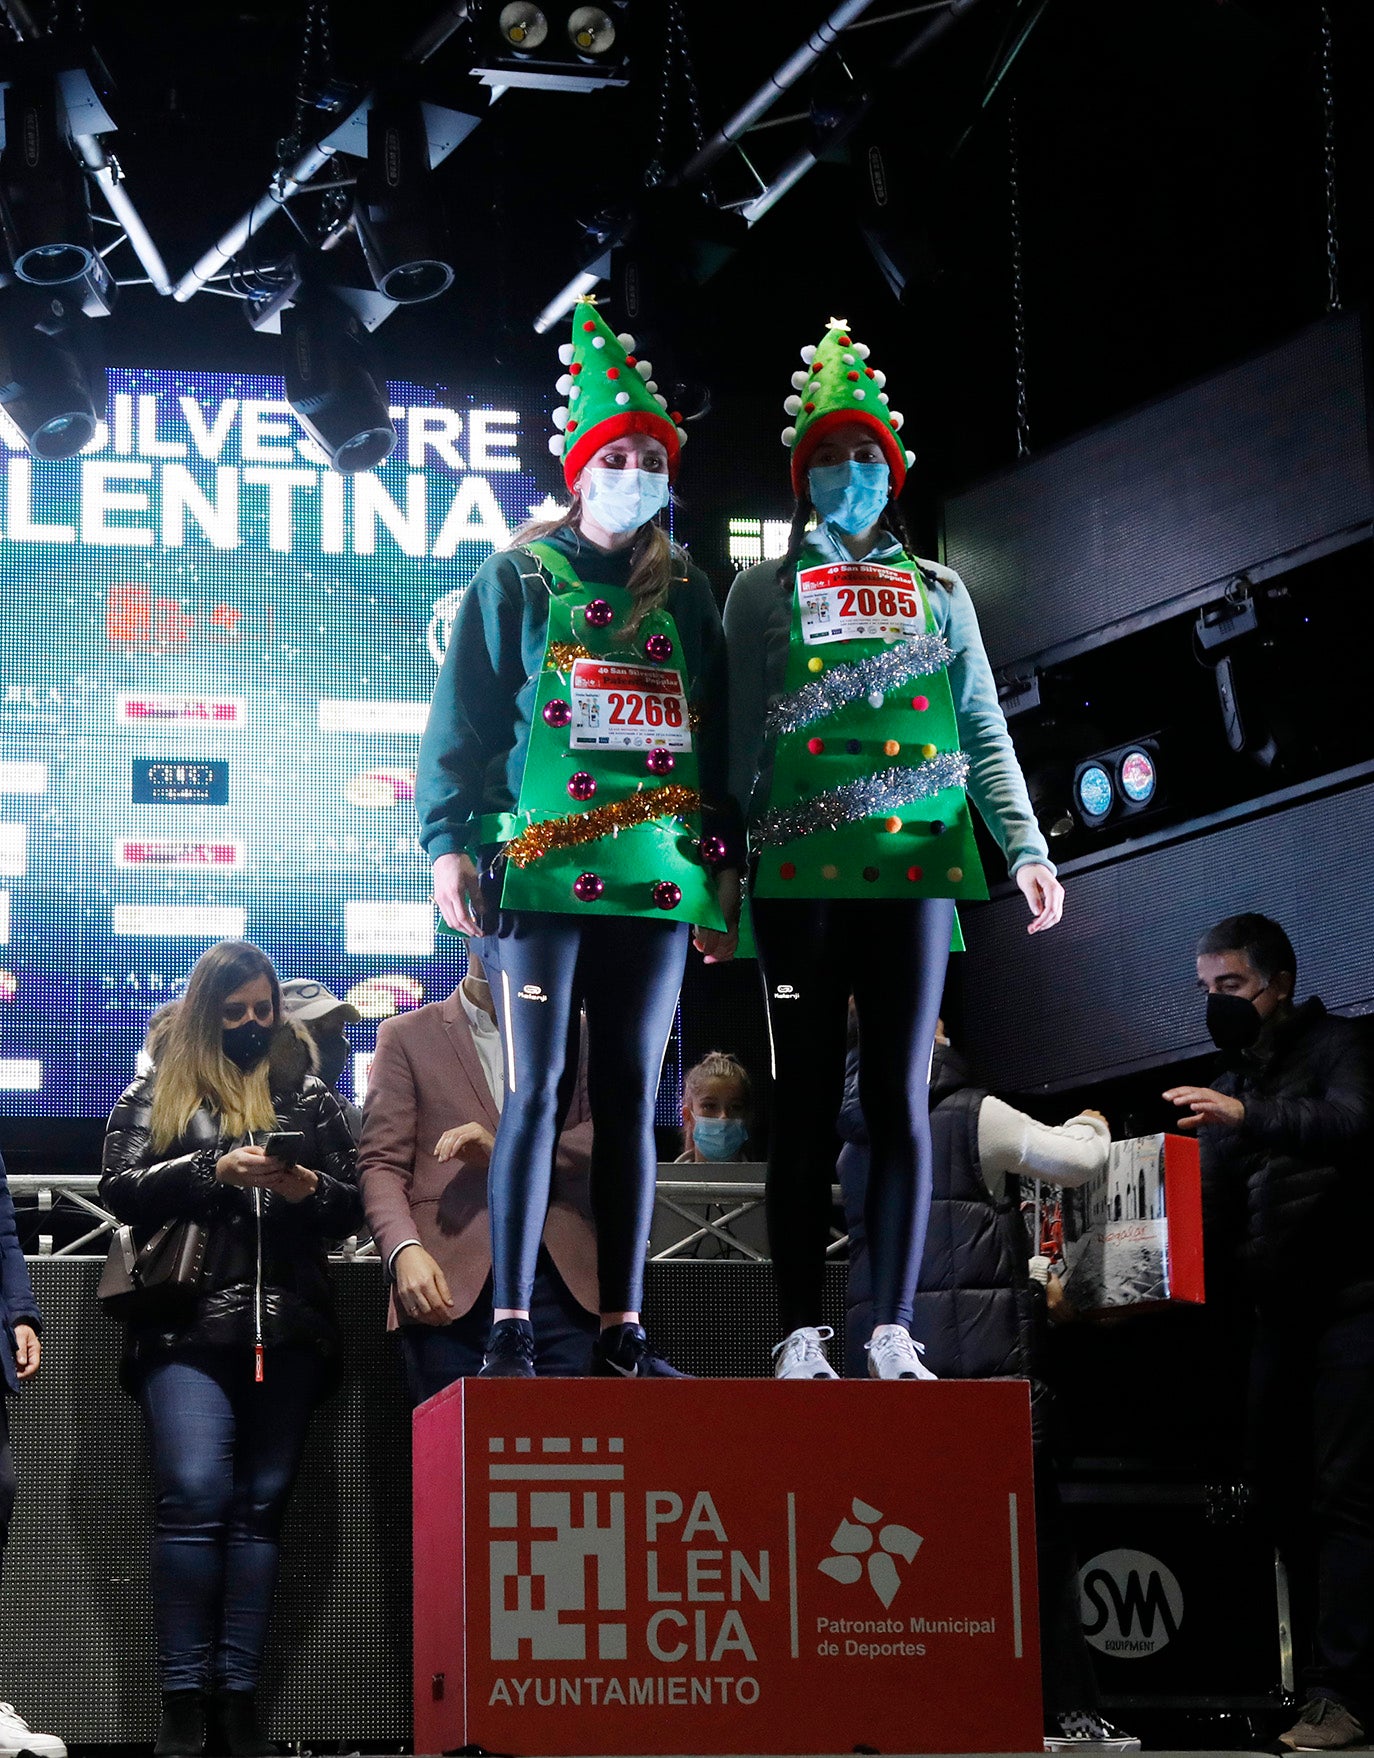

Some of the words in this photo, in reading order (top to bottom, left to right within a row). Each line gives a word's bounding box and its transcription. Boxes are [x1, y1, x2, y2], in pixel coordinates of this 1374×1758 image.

[837, 588, 917, 618] 2085
[608, 693, 682, 727] 2268
[645, 1491, 729, 1542] PA
[647, 1550, 770, 1601] LEN
[646, 1609, 758, 1662] CIA
[817, 1617, 904, 1633] Patronato
[910, 1617, 995, 1636] Municipal
[817, 1640, 839, 1656] de
[845, 1640, 926, 1659] Deportes
[1105, 1641, 1155, 1651] EQUIPMENT
[488, 1677, 760, 1706] AYUNTAMIENTO
